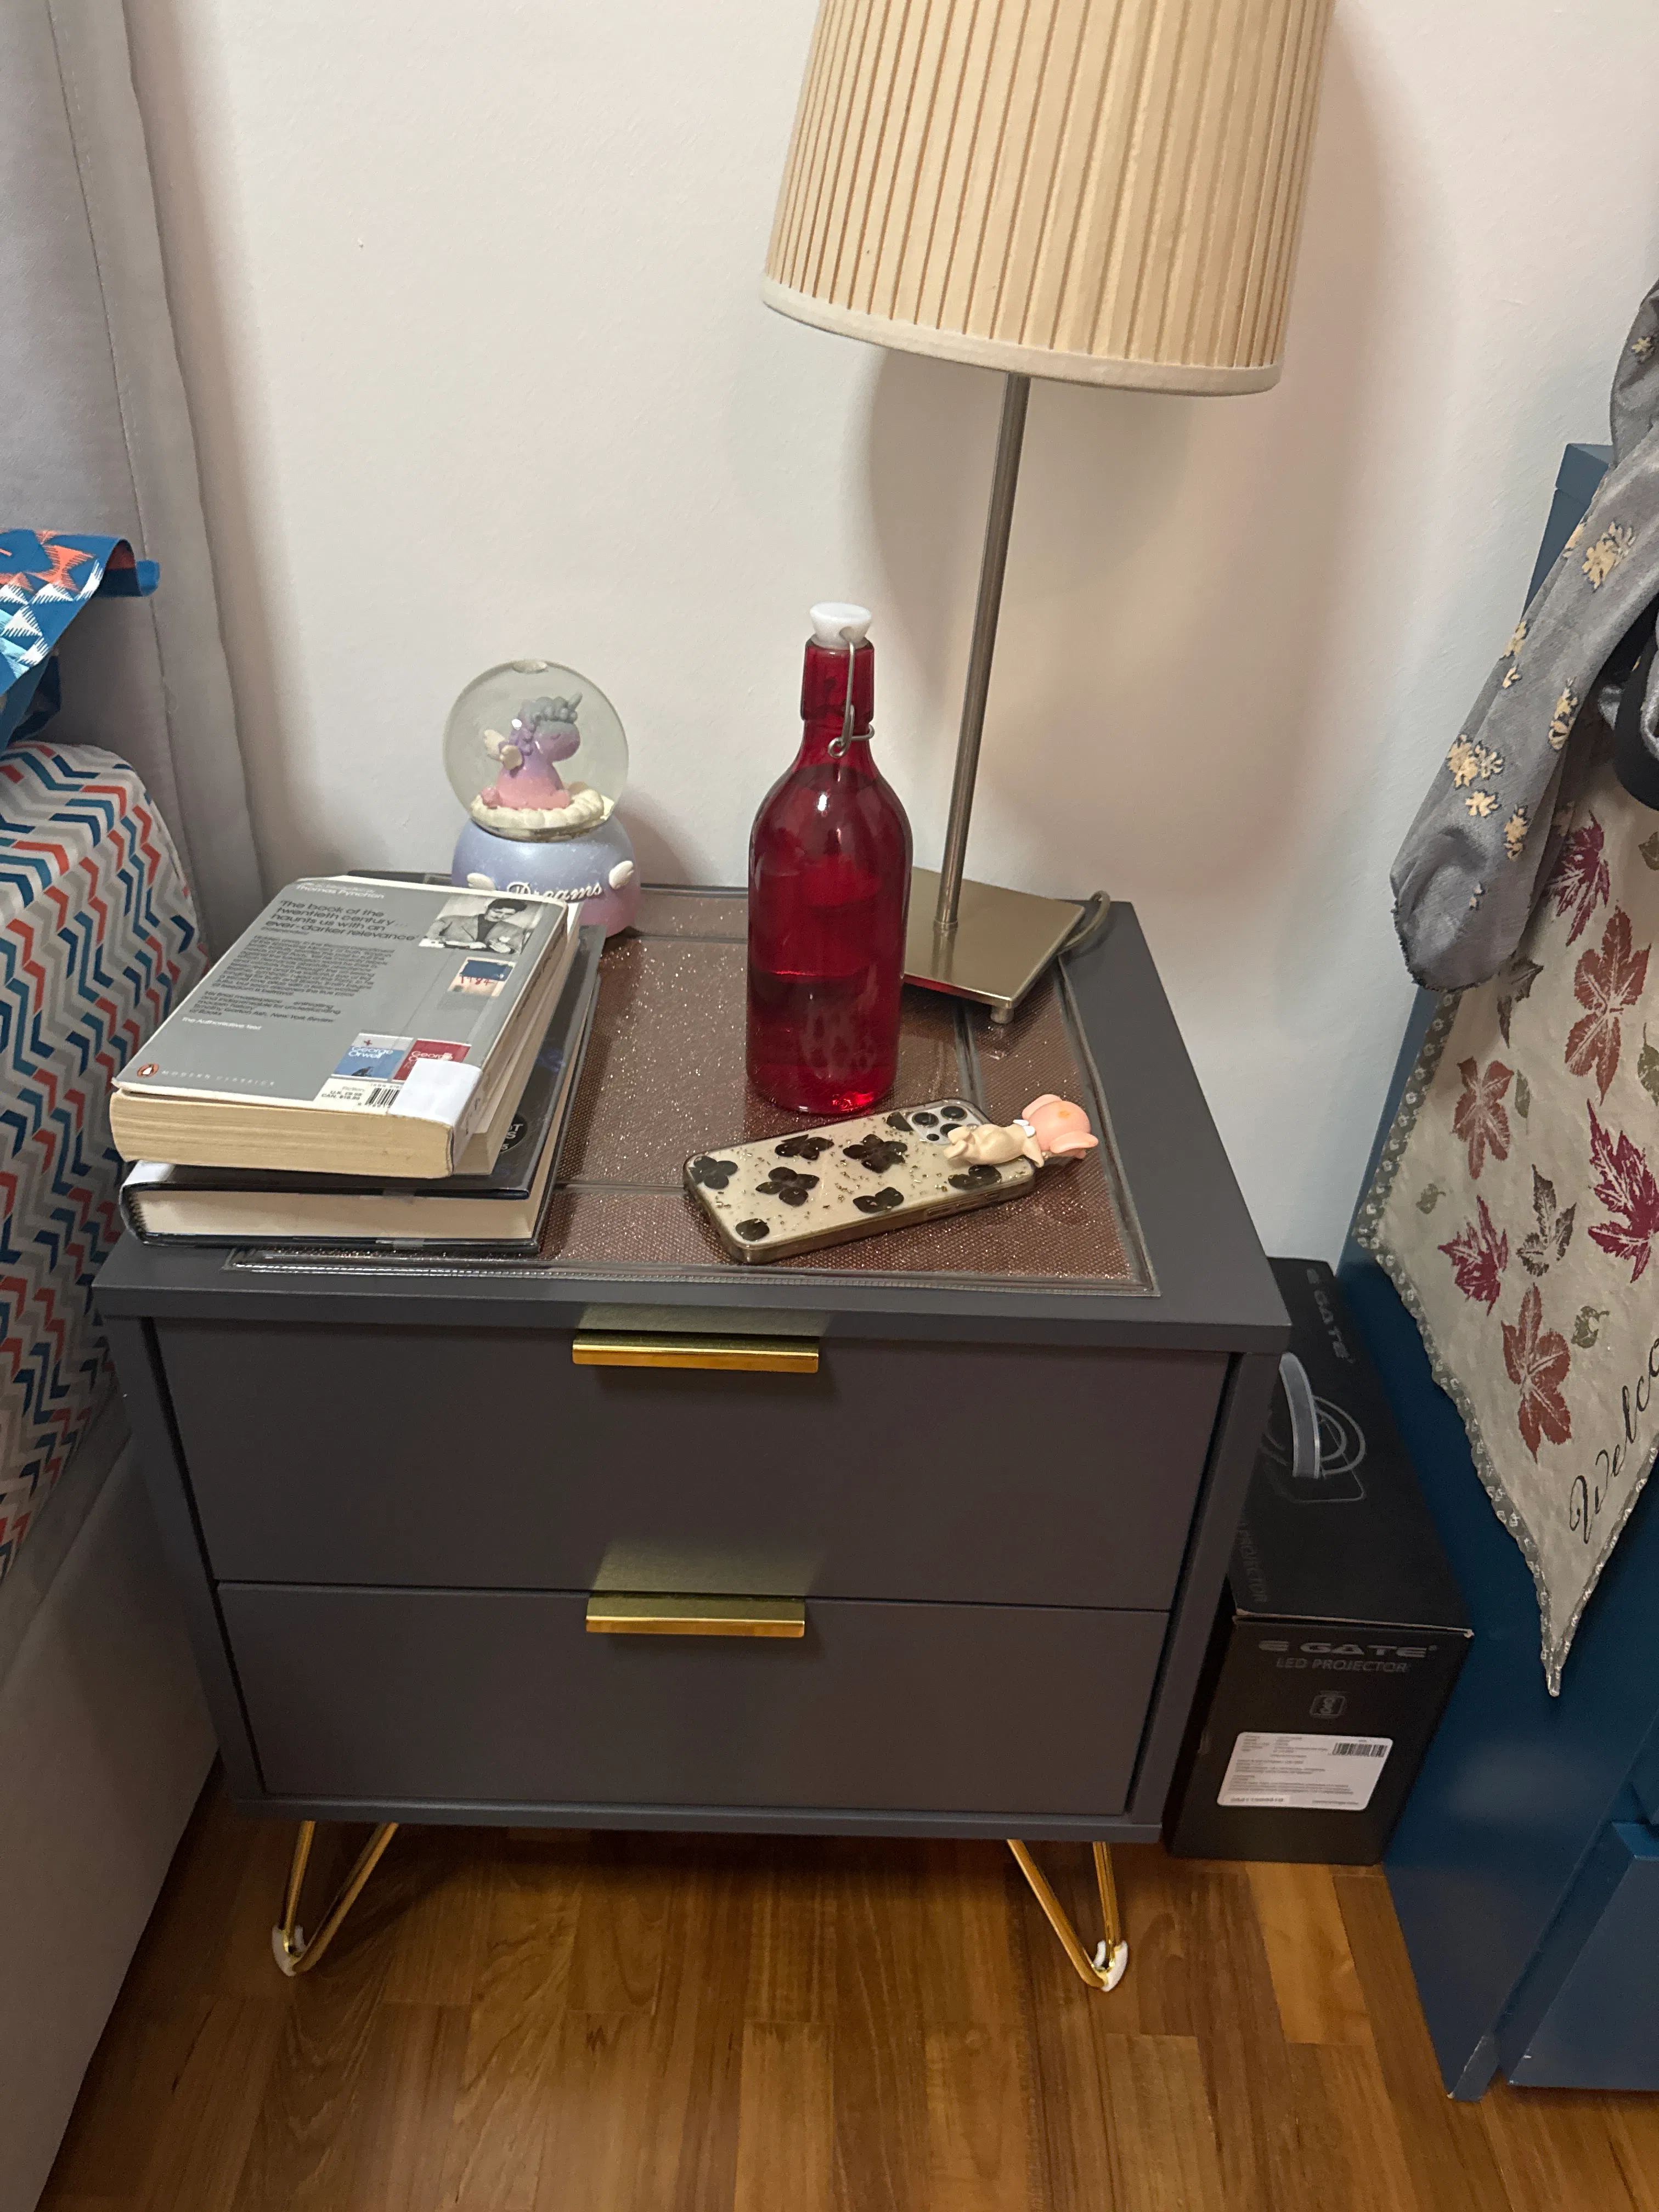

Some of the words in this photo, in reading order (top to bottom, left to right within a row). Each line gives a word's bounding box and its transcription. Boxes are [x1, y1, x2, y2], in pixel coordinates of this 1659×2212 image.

[296, 884, 336, 894] Thomas
[276, 907, 339, 919] twentieth
[341, 915, 395, 926] century
[307, 904, 343, 913] book
[363, 908, 384, 917] the
[270, 913, 317, 924] haunts
[337, 919, 364, 929] with
[1259, 1640, 1289, 1651] E
[1276, 1657, 1308, 1669] LED
[1312, 1658, 1408, 1673] PROJECTOR
